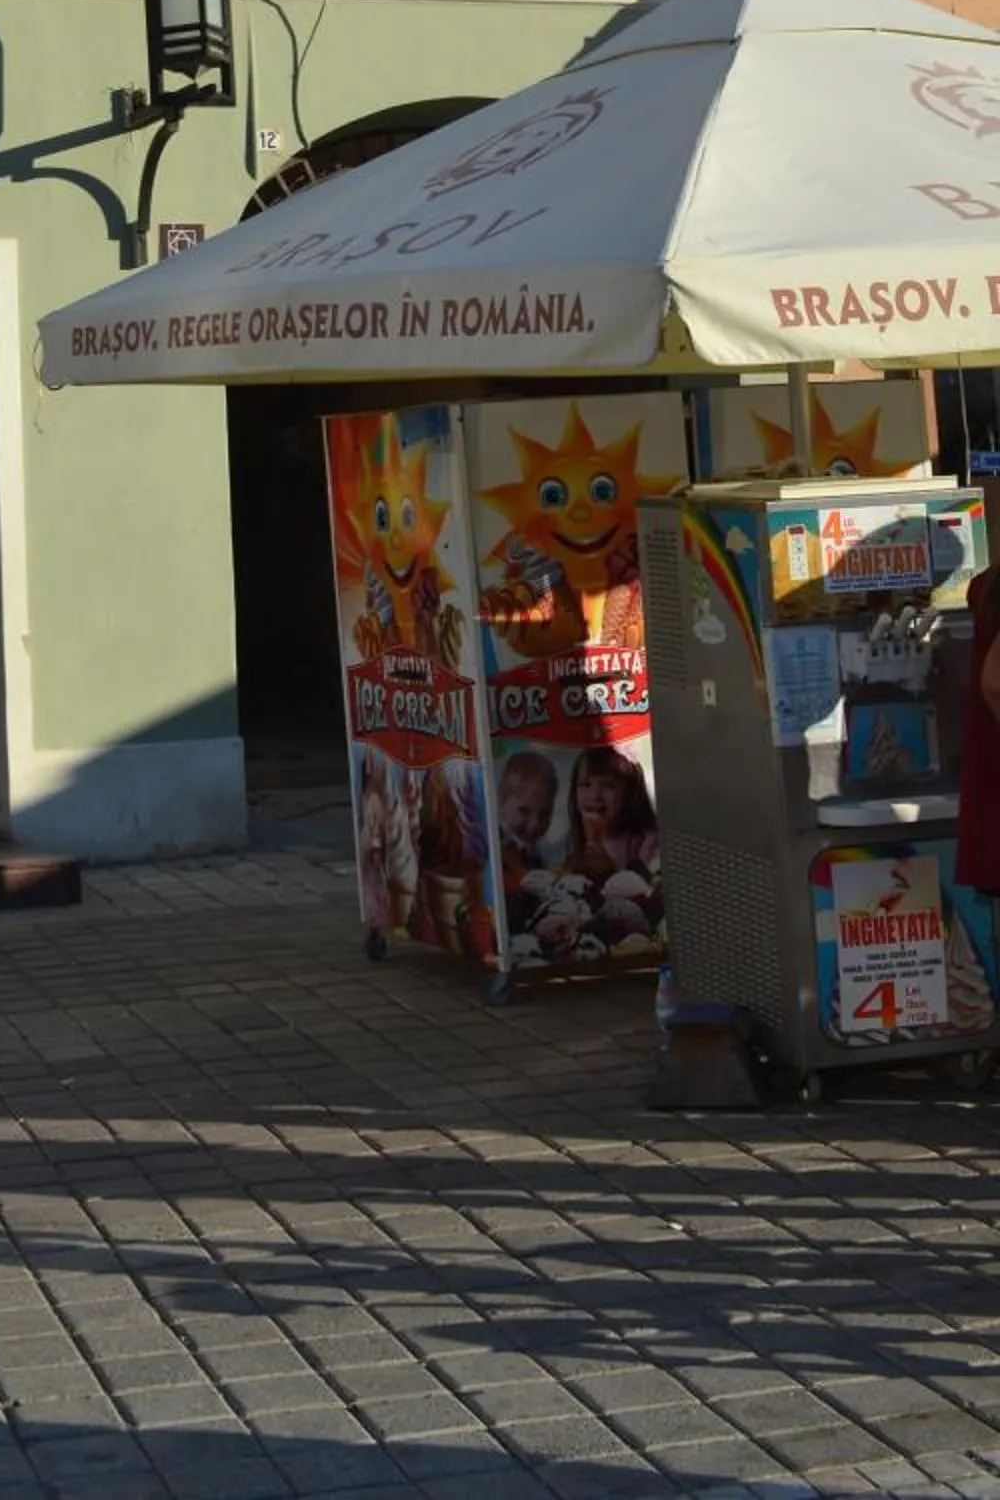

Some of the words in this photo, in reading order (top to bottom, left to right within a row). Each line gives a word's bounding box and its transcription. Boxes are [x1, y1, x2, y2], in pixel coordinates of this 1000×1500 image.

[260, 131, 277, 149] 12
[167, 311, 242, 349] REGELE
[248, 302, 389, 348] ORAȘELOR
[398, 291, 431, 338] ÎN
[438, 284, 595, 338] ROMÂNIA.
[769, 277, 971, 333] BRAȘOV.
[822, 508, 843, 544] 4
[355, 676, 387, 731] ICE
[392, 688, 468, 750] CREAM
[488, 684, 550, 732] ICE
[854, 981, 902, 1029] 4
